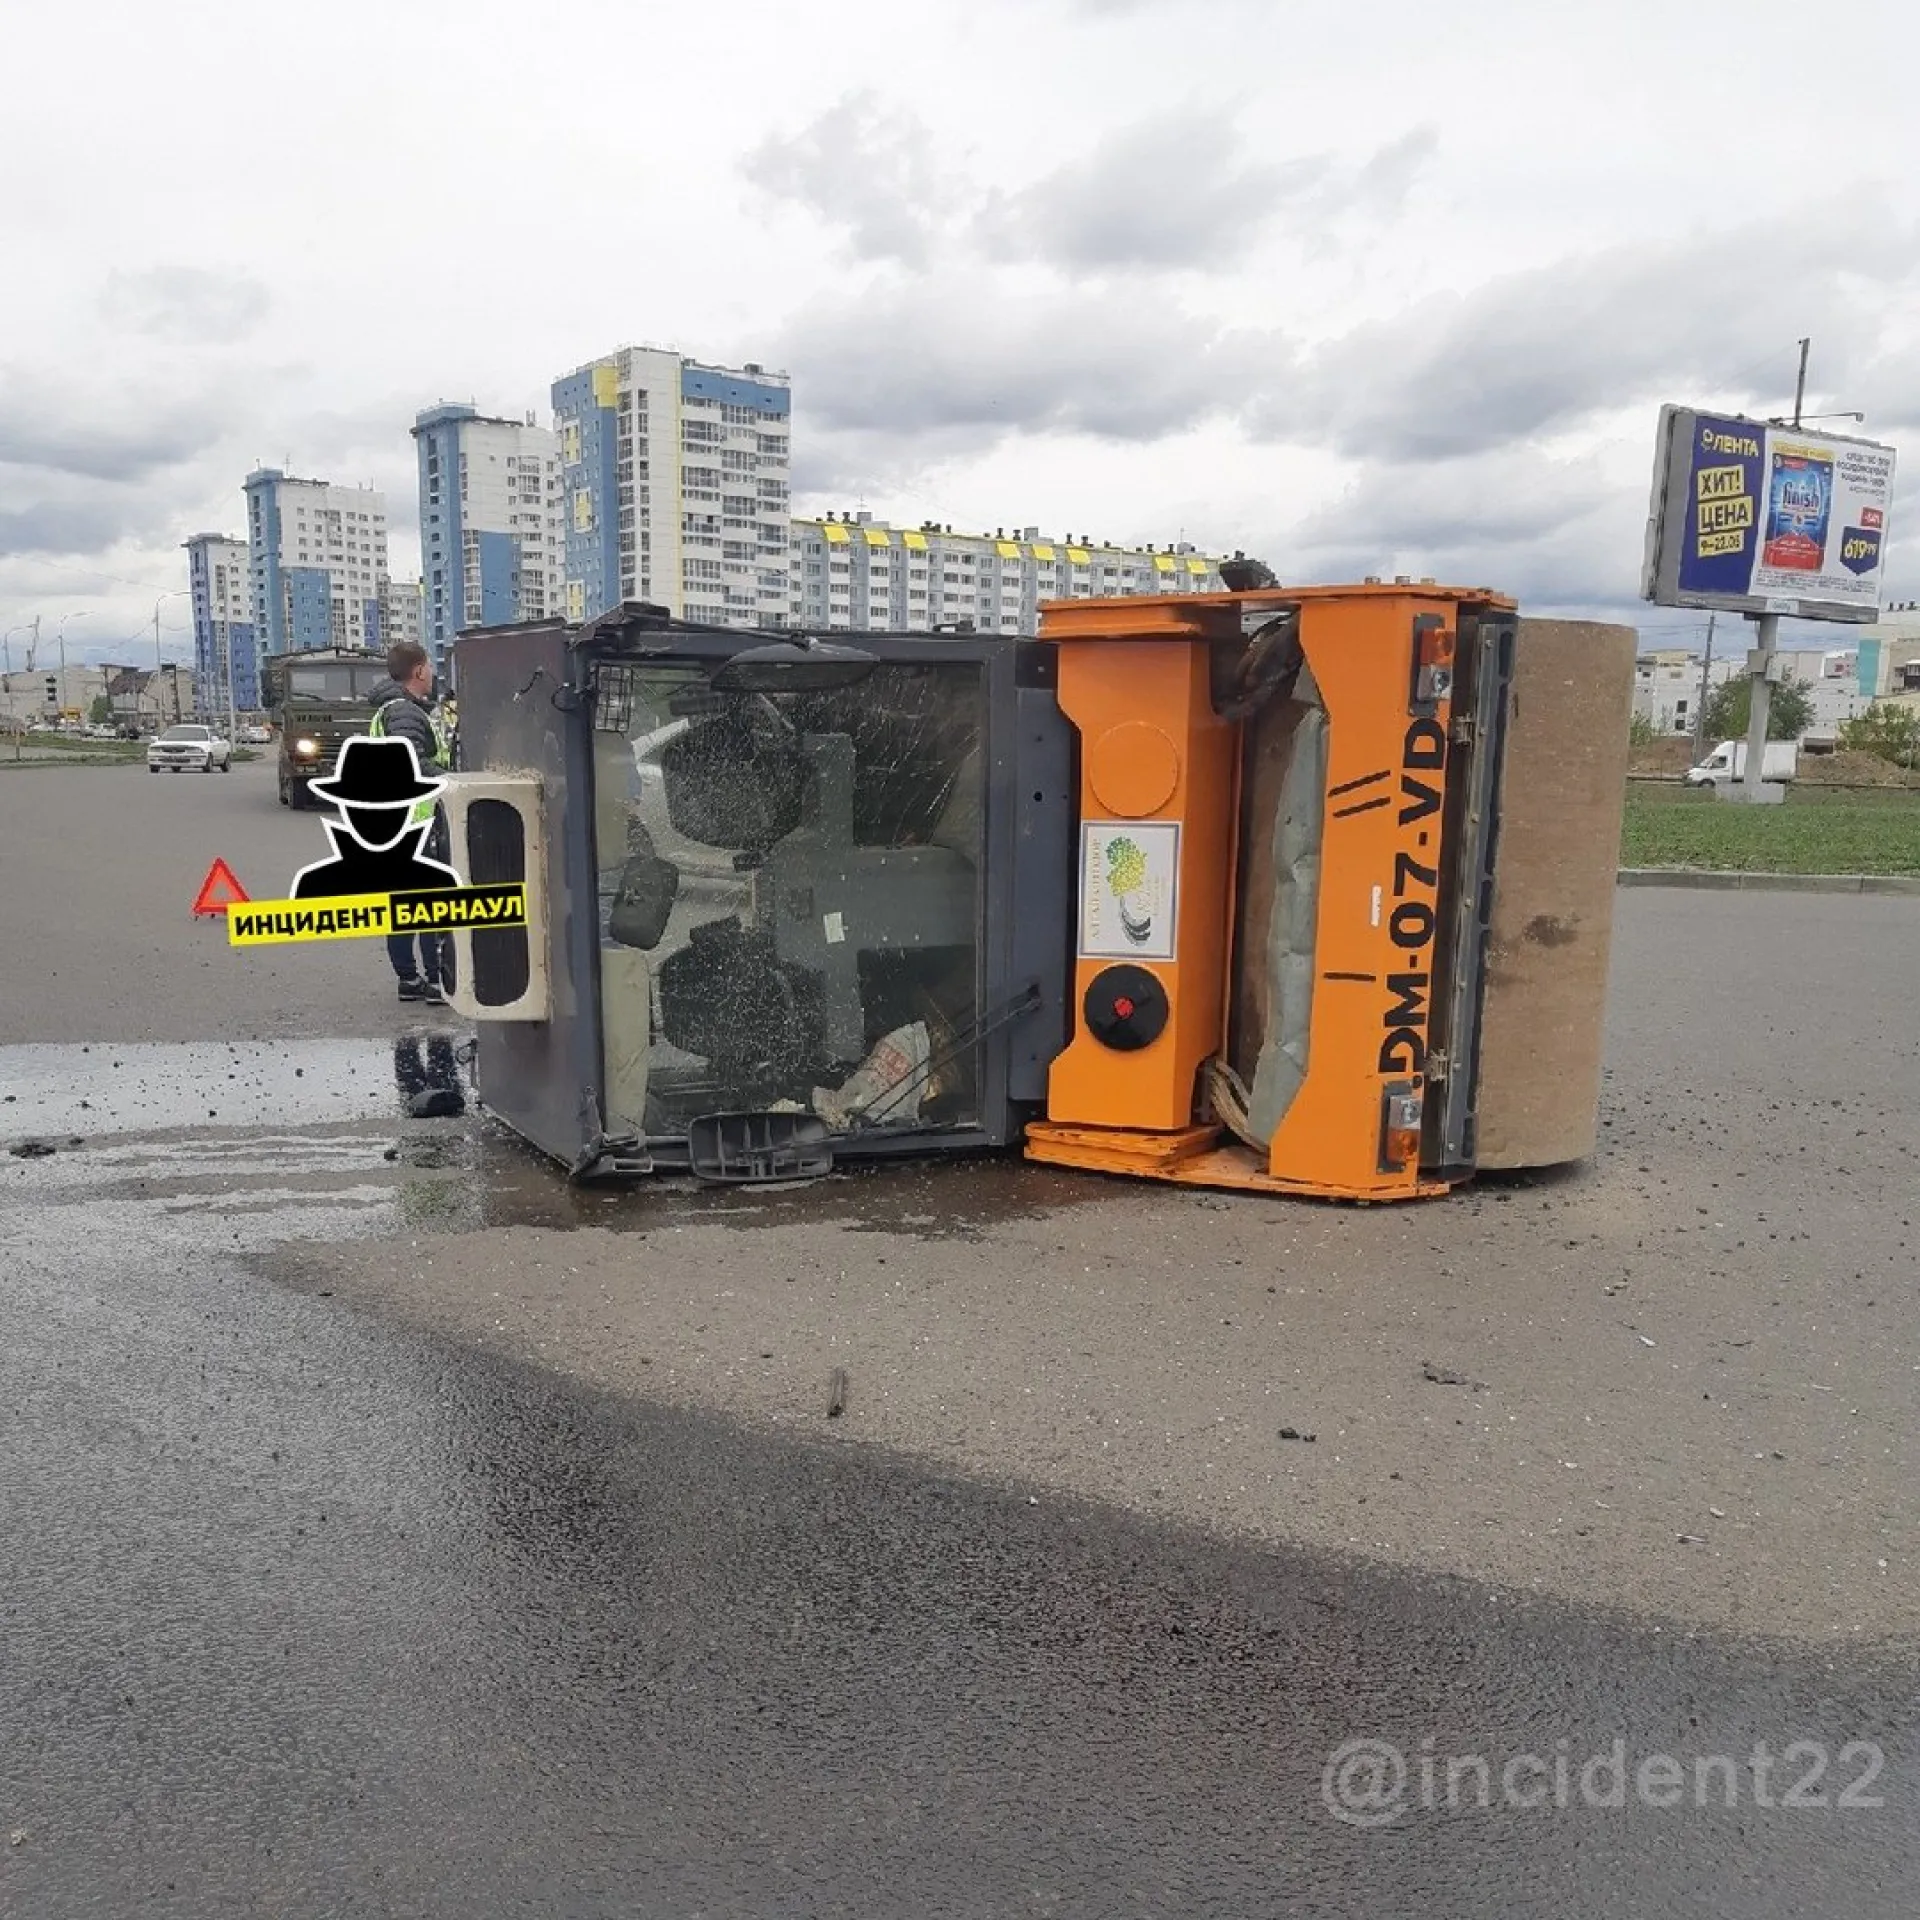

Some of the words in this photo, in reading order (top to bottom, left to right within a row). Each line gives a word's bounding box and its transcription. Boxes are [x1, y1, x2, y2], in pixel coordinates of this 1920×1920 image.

[1713, 434, 1759, 458] ЛЕНТА
[1701, 469, 1740, 495] ХИТ!
[1783, 481, 1820, 509] finish
[1702, 502, 1748, 531] ЦЕНА
